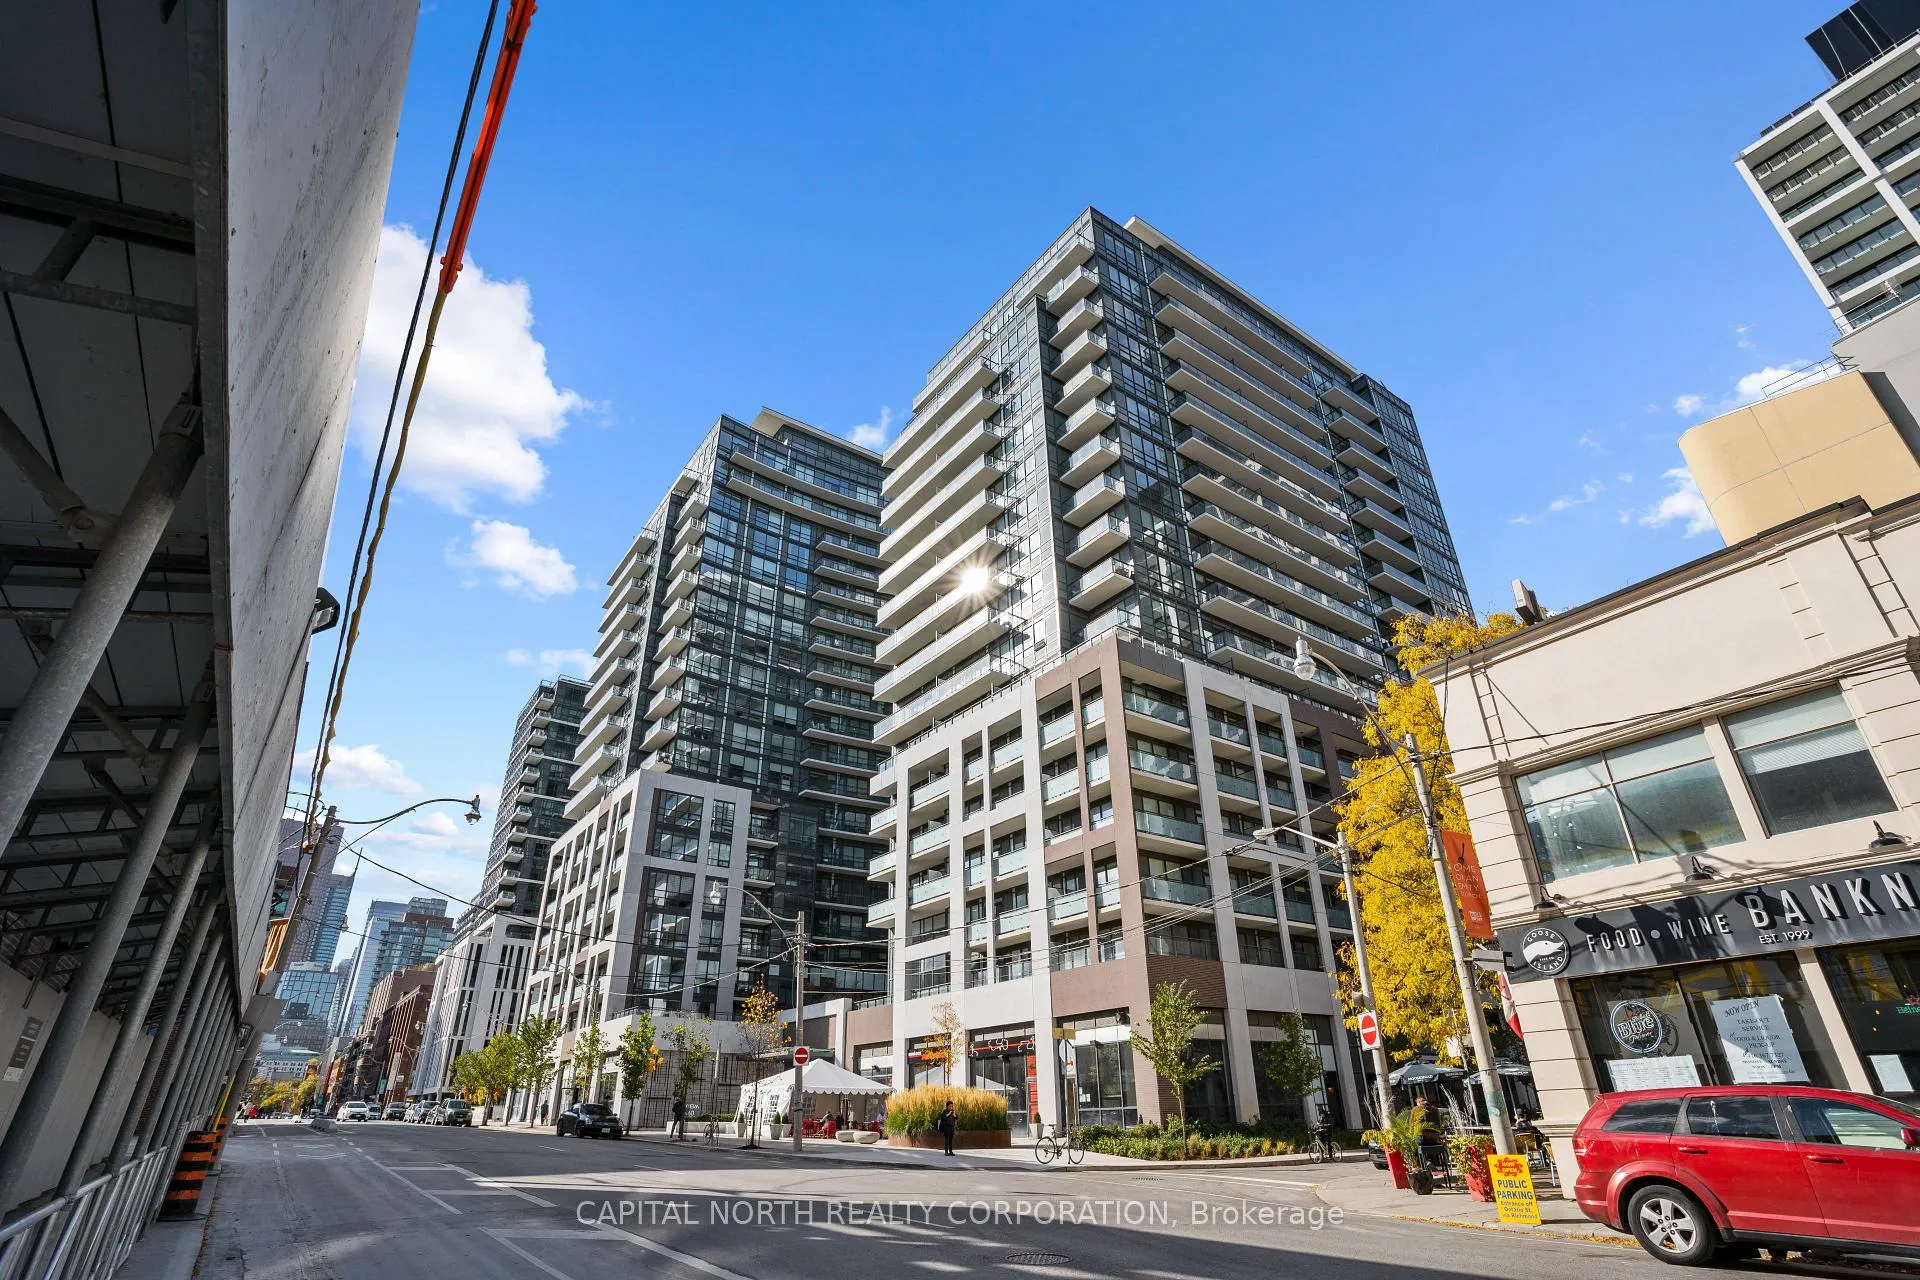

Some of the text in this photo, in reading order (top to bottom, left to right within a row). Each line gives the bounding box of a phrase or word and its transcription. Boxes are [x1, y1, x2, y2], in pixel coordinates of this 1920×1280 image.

[1743, 872, 1916, 928] BANKN
[1527, 930, 1556, 942] GOOSE
[1586, 914, 1730, 952] FOOD WINE
[1758, 930, 1810, 944] EST. 1999
[1533, 956, 1563, 970] ISLAND
[1725, 1006, 1740, 1018] NOW
[1617, 1018, 1655, 1039] Blue
[1497, 1180, 1527, 1188] PUBLIC
[1496, 1191, 1533, 1199] PARKING
